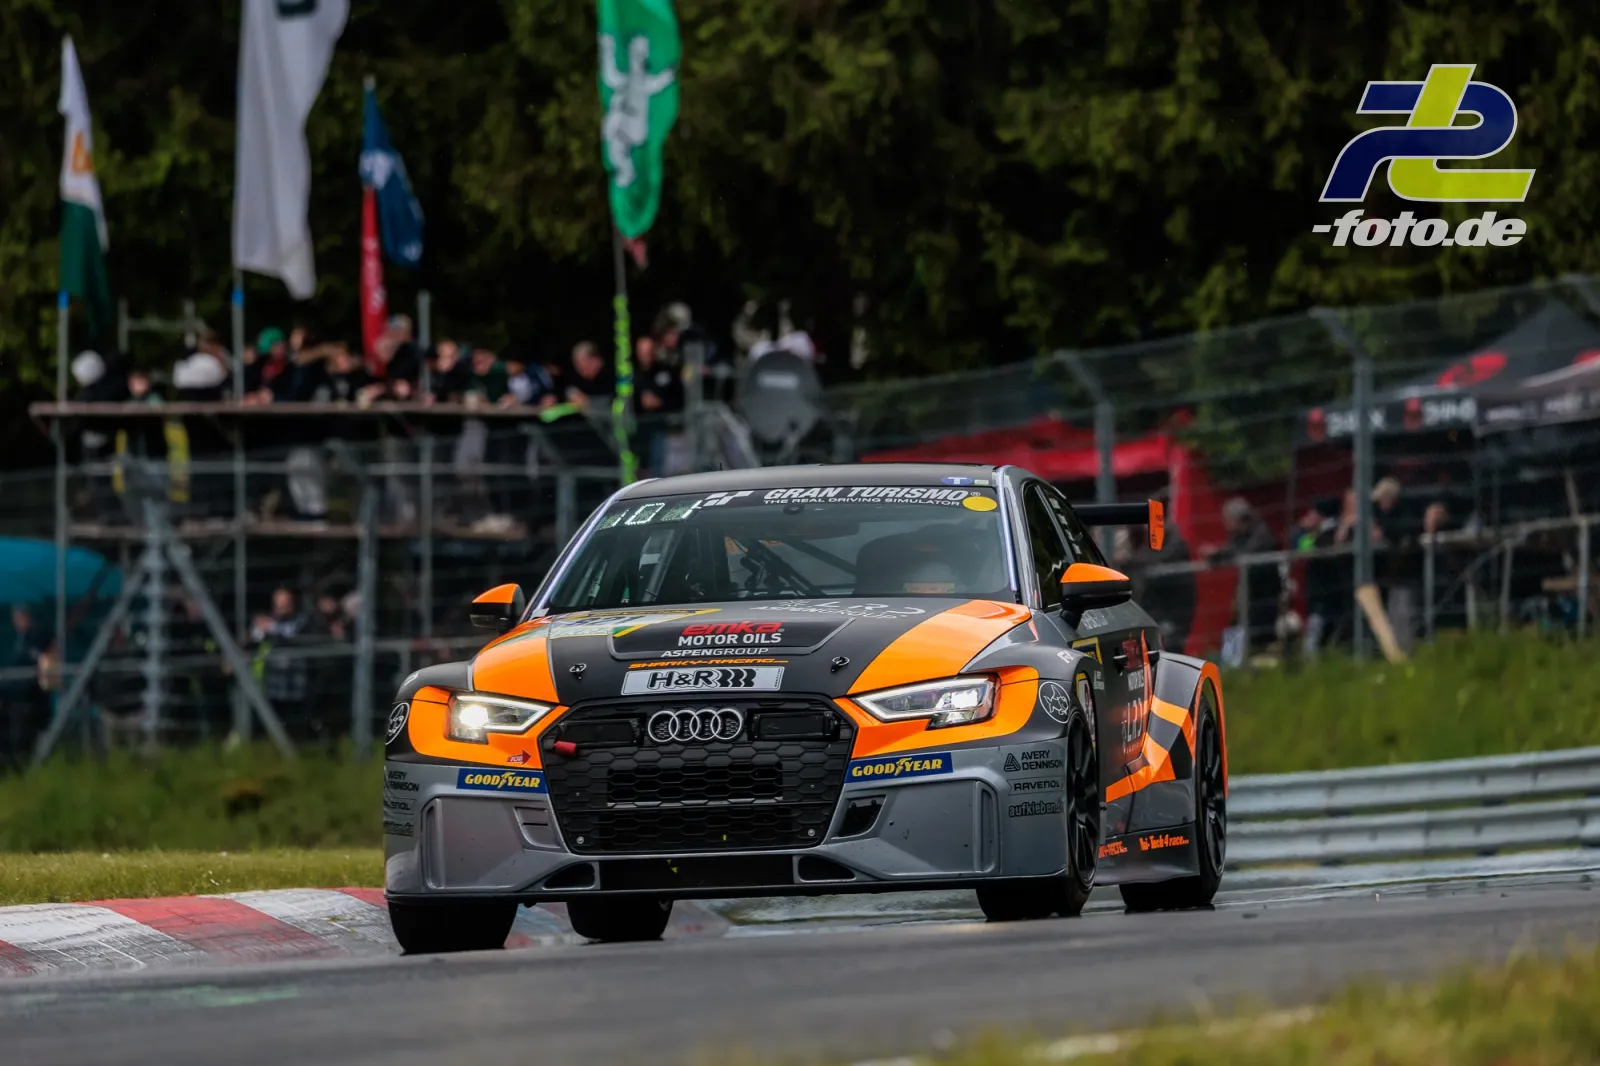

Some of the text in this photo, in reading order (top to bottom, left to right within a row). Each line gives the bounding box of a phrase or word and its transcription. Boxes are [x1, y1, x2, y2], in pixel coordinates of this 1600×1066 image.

[763, 486, 846, 501] GRAN
[885, 498, 961, 507] SIMULATOR
[681, 621, 782, 636] emka
[678, 632, 782, 647] MOTOR OILS
[661, 647, 769, 658] ASPENGROUP
[648, 669, 714, 691] H&R
[1021, 750, 1051, 761] AVERY
[852, 756, 944, 778] GOODYEAR
[1022, 759, 1064, 771] DENNISON
[464, 771, 541, 789] GOODYEAR
[1013, 780, 1061, 792] RAVENOL
